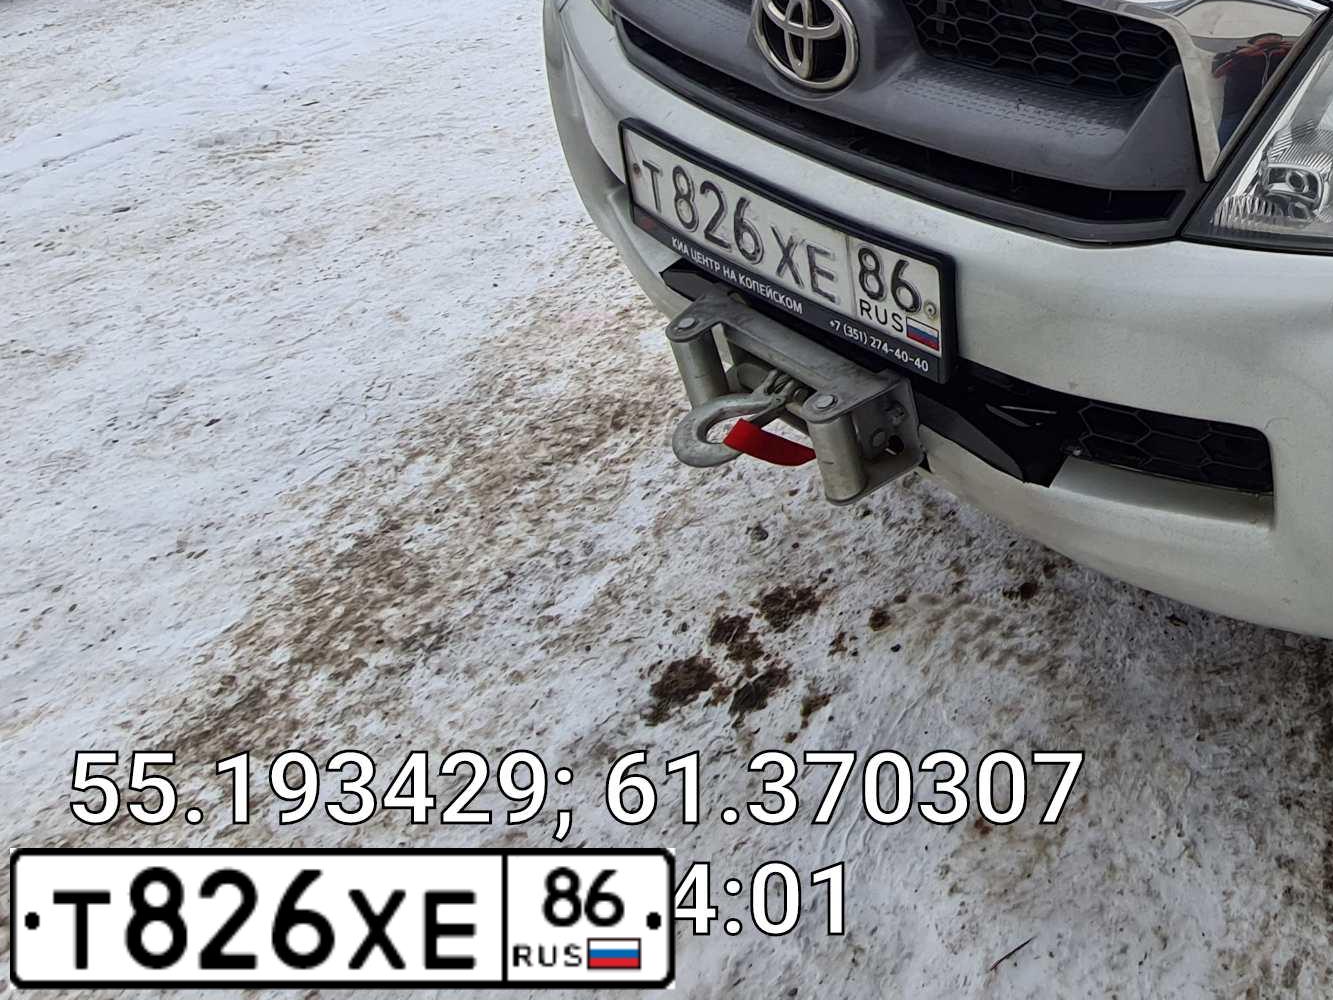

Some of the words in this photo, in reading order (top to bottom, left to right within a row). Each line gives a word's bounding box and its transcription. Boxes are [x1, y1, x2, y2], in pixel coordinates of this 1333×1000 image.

[643, 160, 838, 304] Т826ХЕ
[858, 247, 922, 314] 86
[672, 236, 690, 256] КИА
[690, 247, 721, 273] ЦЕНТР
[722, 265, 737, 282] НА
[739, 273, 803, 314] КОПЕЙСКОМ
[843, 323, 868, 345] (351)
[869, 336, 930, 372] 274-40-40
[859, 300, 904, 333] RUS
